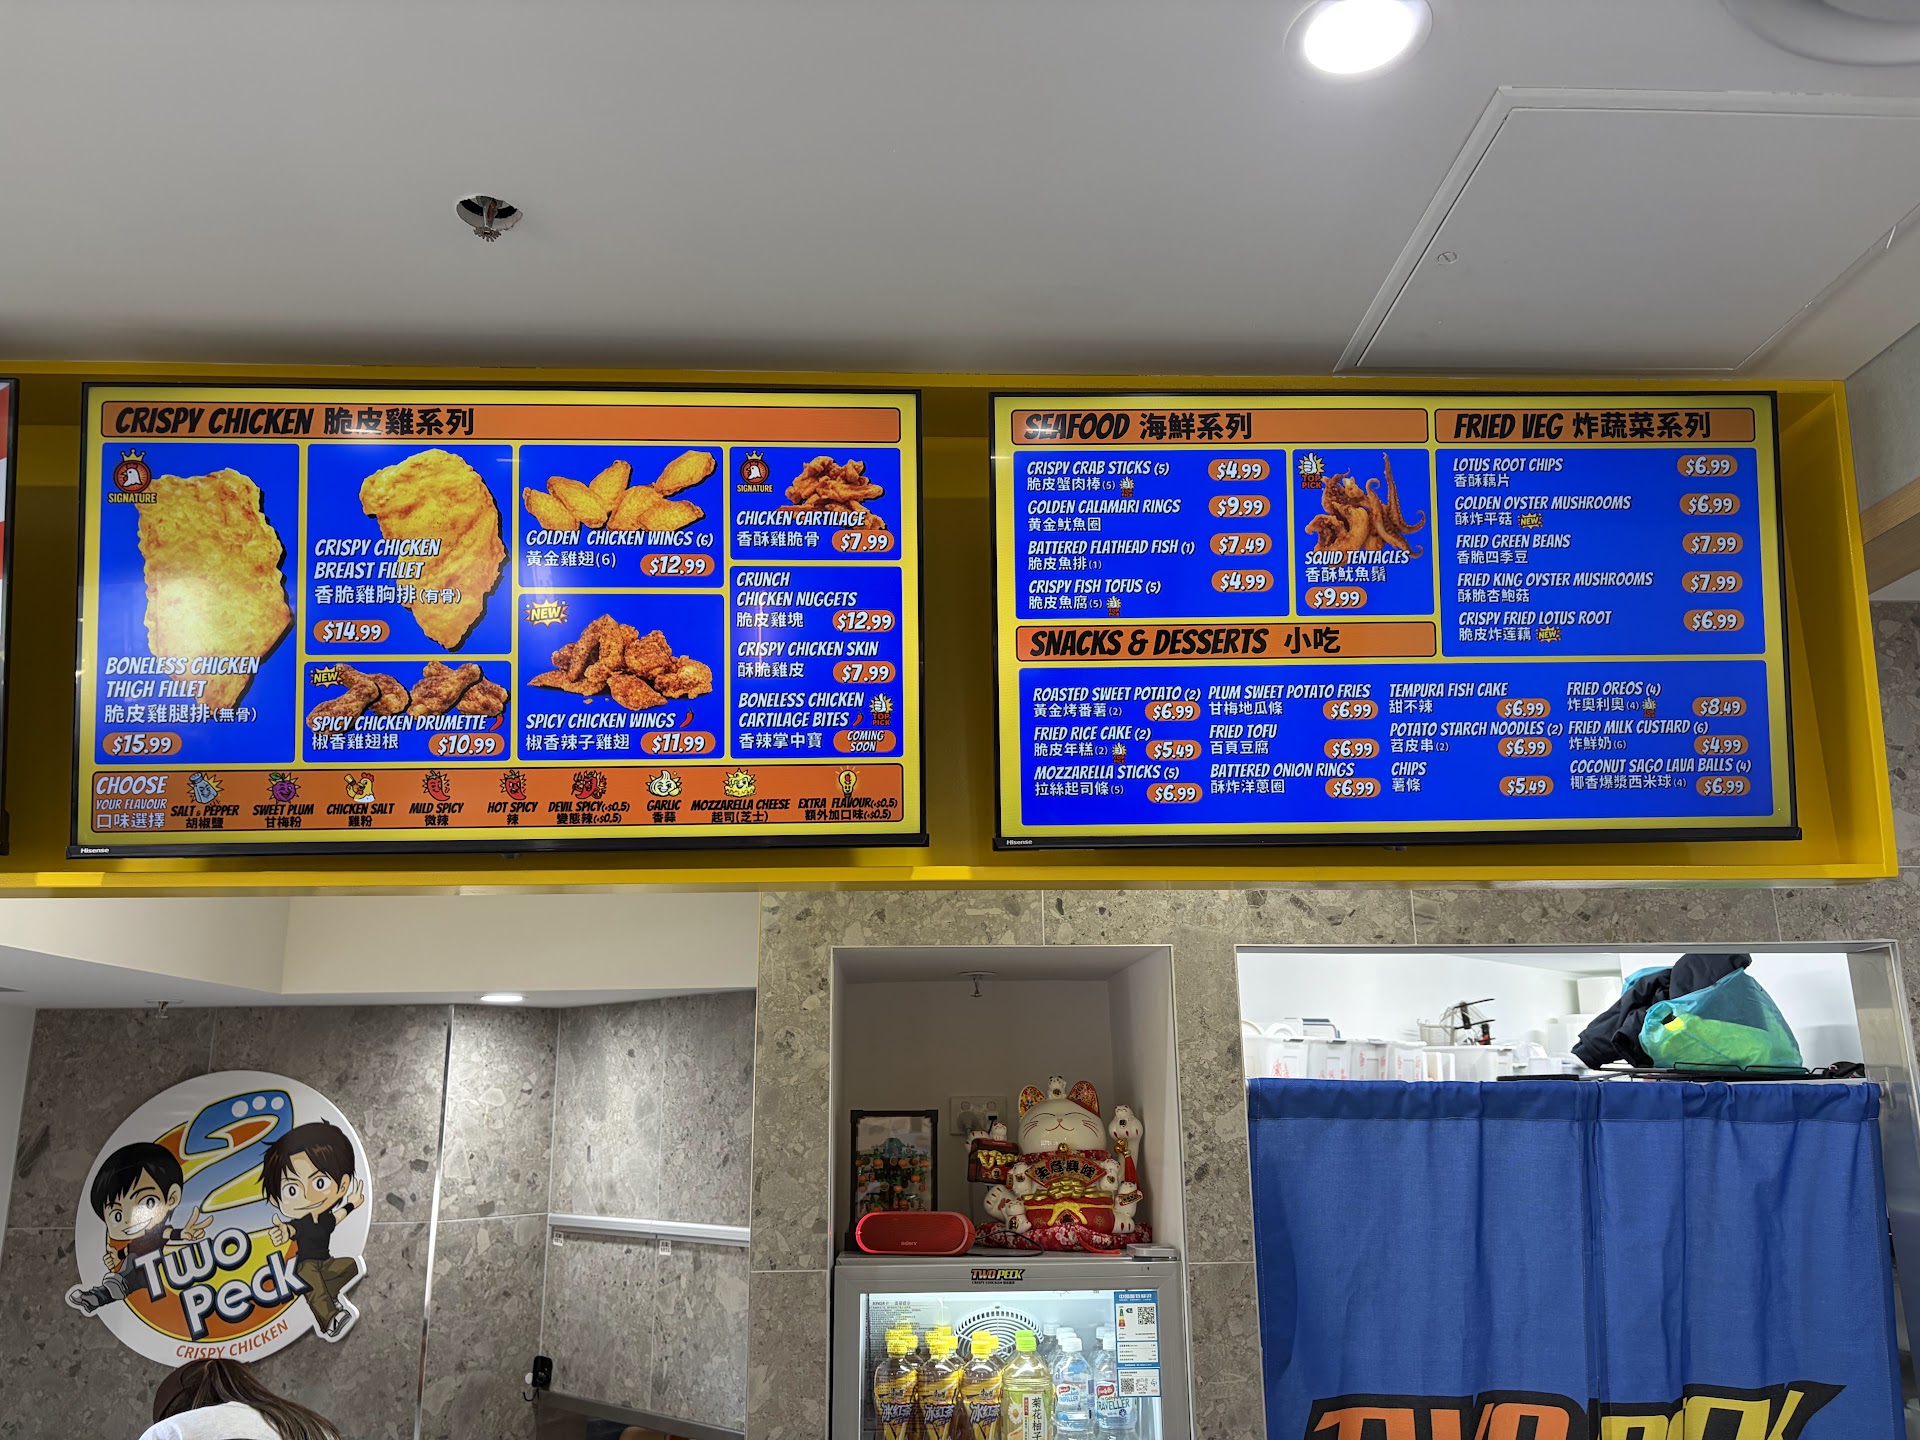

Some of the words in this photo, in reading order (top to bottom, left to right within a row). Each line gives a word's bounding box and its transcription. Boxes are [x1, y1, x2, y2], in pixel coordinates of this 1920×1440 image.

[115, 407, 204, 434] CRISPY
[208, 407, 315, 435] CHICKEN
[323, 407, 474, 437] 脆皮雞系列
[1024, 413, 1130, 440] SEAFOOD
[1139, 412, 1253, 440] 海鮮系列
[1453, 414, 1515, 440] FRIED
[1521, 414, 1564, 440] VEG
[1572, 411, 1712, 440] 炸蔬菜系列
[1027, 461, 1071, 476] CRISPY
[1072, 461, 1106, 476] CRAB
[1107, 460, 1152, 475] STICKS
[1154, 462, 1170, 477] (5)
[1453, 458, 1491, 472] LOTUS
[1492, 458, 1527, 472] ROOT
[1528, 457, 1564, 472] CHIPS
[1685, 456, 1732, 477] $6.99
[1301, 481, 1322, 490] PICK
[1302, 474, 1321, 483] TOP
[1453, 473, 1510, 488] 香酥藕片
[737, 484, 773, 493] SIGNATURE
[108, 493, 156, 504] SIGNATURE
[1028, 500, 1075, 515] GOLDEN
[1078, 500, 1141, 514] CALAMARI
[1142, 499, 1182, 514] RINGS
[1217, 496, 1263, 518] $9.99
[1454, 496, 1502, 510] GOLDEN
[1503, 496, 1549, 510] OYSTER
[1550, 495, 1632, 510] MUSHROOMS
[736, 510, 793, 528] CHICKEN
[794, 510, 866, 527] CARTILAGE
[1455, 511, 1513, 526] 酥炸平菇
[526, 530, 580, 548] GOLDEN
[586, 530, 646, 547] CHICKEN
[647, 530, 693, 547] WINGS
[696, 533, 714, 548] (6)
[736, 531, 820, 548] 香酥雞脆骨
[840, 532, 888, 552] $7.99
[1456, 534, 1489, 549] FRIED
[1491, 534, 1531, 549] GREEN
[1532, 534, 1572, 548] BEANS
[1690, 533, 1737, 554] $7.99
[314, 539, 371, 557] CRISPY
[374, 539, 441, 557] CHICKEN
[649, 555, 706, 576] $12.99
[1304, 550, 1344, 565] SQUID
[1346, 549, 1411, 565] TENTACLES
[1456, 550, 1529, 565] 香脆四季豆
[314, 561, 375, 580] BREAST
[378, 561, 425, 579] FILLET
[1457, 573, 1491, 587] FRIED
[1493, 572, 1524, 587] KING
[1525, 572, 1571, 587] OYSTER
[1572, 571, 1654, 587] MUSHROOMS
[736, 571, 790, 588] CRUNCH
[736, 591, 794, 607] CHICKEN
[795, 591, 857, 607] NUGGETS
[1313, 587, 1360, 609] $9.99
[531, 605, 563, 621] NEW
[736, 611, 804, 629] 脆皮雞塊
[836, 611, 893, 631] $12.99
[322, 622, 382, 643] $14.99
[737, 641, 786, 657] CRISPY
[787, 641, 845, 657] CHICKEN
[846, 641, 879, 656] SKIN
[1030, 629, 1124, 656] SNACKS
[1127, 629, 1149, 655] &
[1153, 628, 1269, 655] DESSERTS
[1284, 627, 1341, 654] 小吃
[105, 657, 187, 676] BONELESS
[190, 656, 261, 675] CHICKEN
[737, 661, 805, 679] 酥脆雞皮
[841, 662, 889, 682] $7.99
[313, 670, 339, 684] NEW
[106, 681, 155, 699] THIGH
[158, 680, 207, 699] FILLET
[1207, 685, 1242, 700] PLUM
[1243, 685, 1286, 700] SWEET
[1286, 684, 1335, 699] POTATO
[1336, 683, 1373, 698] FRIES
[1389, 683, 1445, 698] TEMPURA
[1447, 683, 1475, 697] FISH
[1476, 682, 1510, 697] CAKE
[1567, 681, 1600, 696] FRIED
[1602, 681, 1643, 696] OREOS
[1645, 683, 1662, 697] (4)
[738, 692, 805, 709] BONELESS
[808, 691, 865, 708] CHICKEN
[1208, 701, 1283, 716] 甘梅地瓜條
[1389, 699, 1434, 714] 甜不辣
[312, 715, 354, 733] SPICY
[356, 715, 414, 732] CHICKEN
[415, 714, 488, 732] DRUMETTE
[526, 713, 566, 729] SPICY
[568, 712, 627, 729] CHICKEN
[629, 711, 676, 729] WINGS
[738, 711, 811, 728] CARTILAGE
[812, 711, 849, 727] BITES
[846, 730, 885, 742] COMING
[1209, 724, 1244, 739] FRIED
[1246, 723, 1279, 739] TOFU
[111, 733, 172, 756] $15.99
[311, 733, 400, 751] 椒香雞翅根
[437, 734, 496, 755] $10.99
[526, 733, 630, 751] 椒香辣子雞翅
[651, 733, 705, 754] $11.99
[738, 732, 823, 750] 香辣掌中寶
[850, 740, 877, 752] SOON
[1210, 763, 1271, 778] BATTERED
[1272, 763, 1314, 778] ONION
[1315, 762, 1356, 777] RINGS
[1391, 761, 1428, 776] CHIPS
[1569, 759, 1627, 774] COCONUT
[1628, 758, 1664, 773] SAGO
[1665, 758, 1695, 773] LAVA
[1697, 757, 1734, 772] BALLS
[1735, 759, 1752, 774] (4)
[96, 775, 168, 795] CHOOSE
[96, 798, 121, 811] YOUR
[124, 798, 168, 811] FLAVOUR
[252, 804, 287, 817] SWEET
[288, 804, 315, 816] PLUM
[326, 803, 370, 816] CHICKEN
[371, 802, 396, 815] SALT
[409, 802, 435, 815] MILD
[436, 802, 465, 814] SPICY
[487, 802, 507, 813] HOT
[509, 801, 539, 813] SPICY
[646, 800, 682, 811] GARLIC
[96, 812, 165, 829] 口味選擇
[80, 846, 110, 855] Hisense
[1006, 838, 1033, 846] Hisense
[971, 1269, 997, 1280] TWO
[178, 1250, 313, 1341] Peck
[176, 1344, 225, 1360] CRISPY
[229, 1319, 289, 1358] CHICKEN
